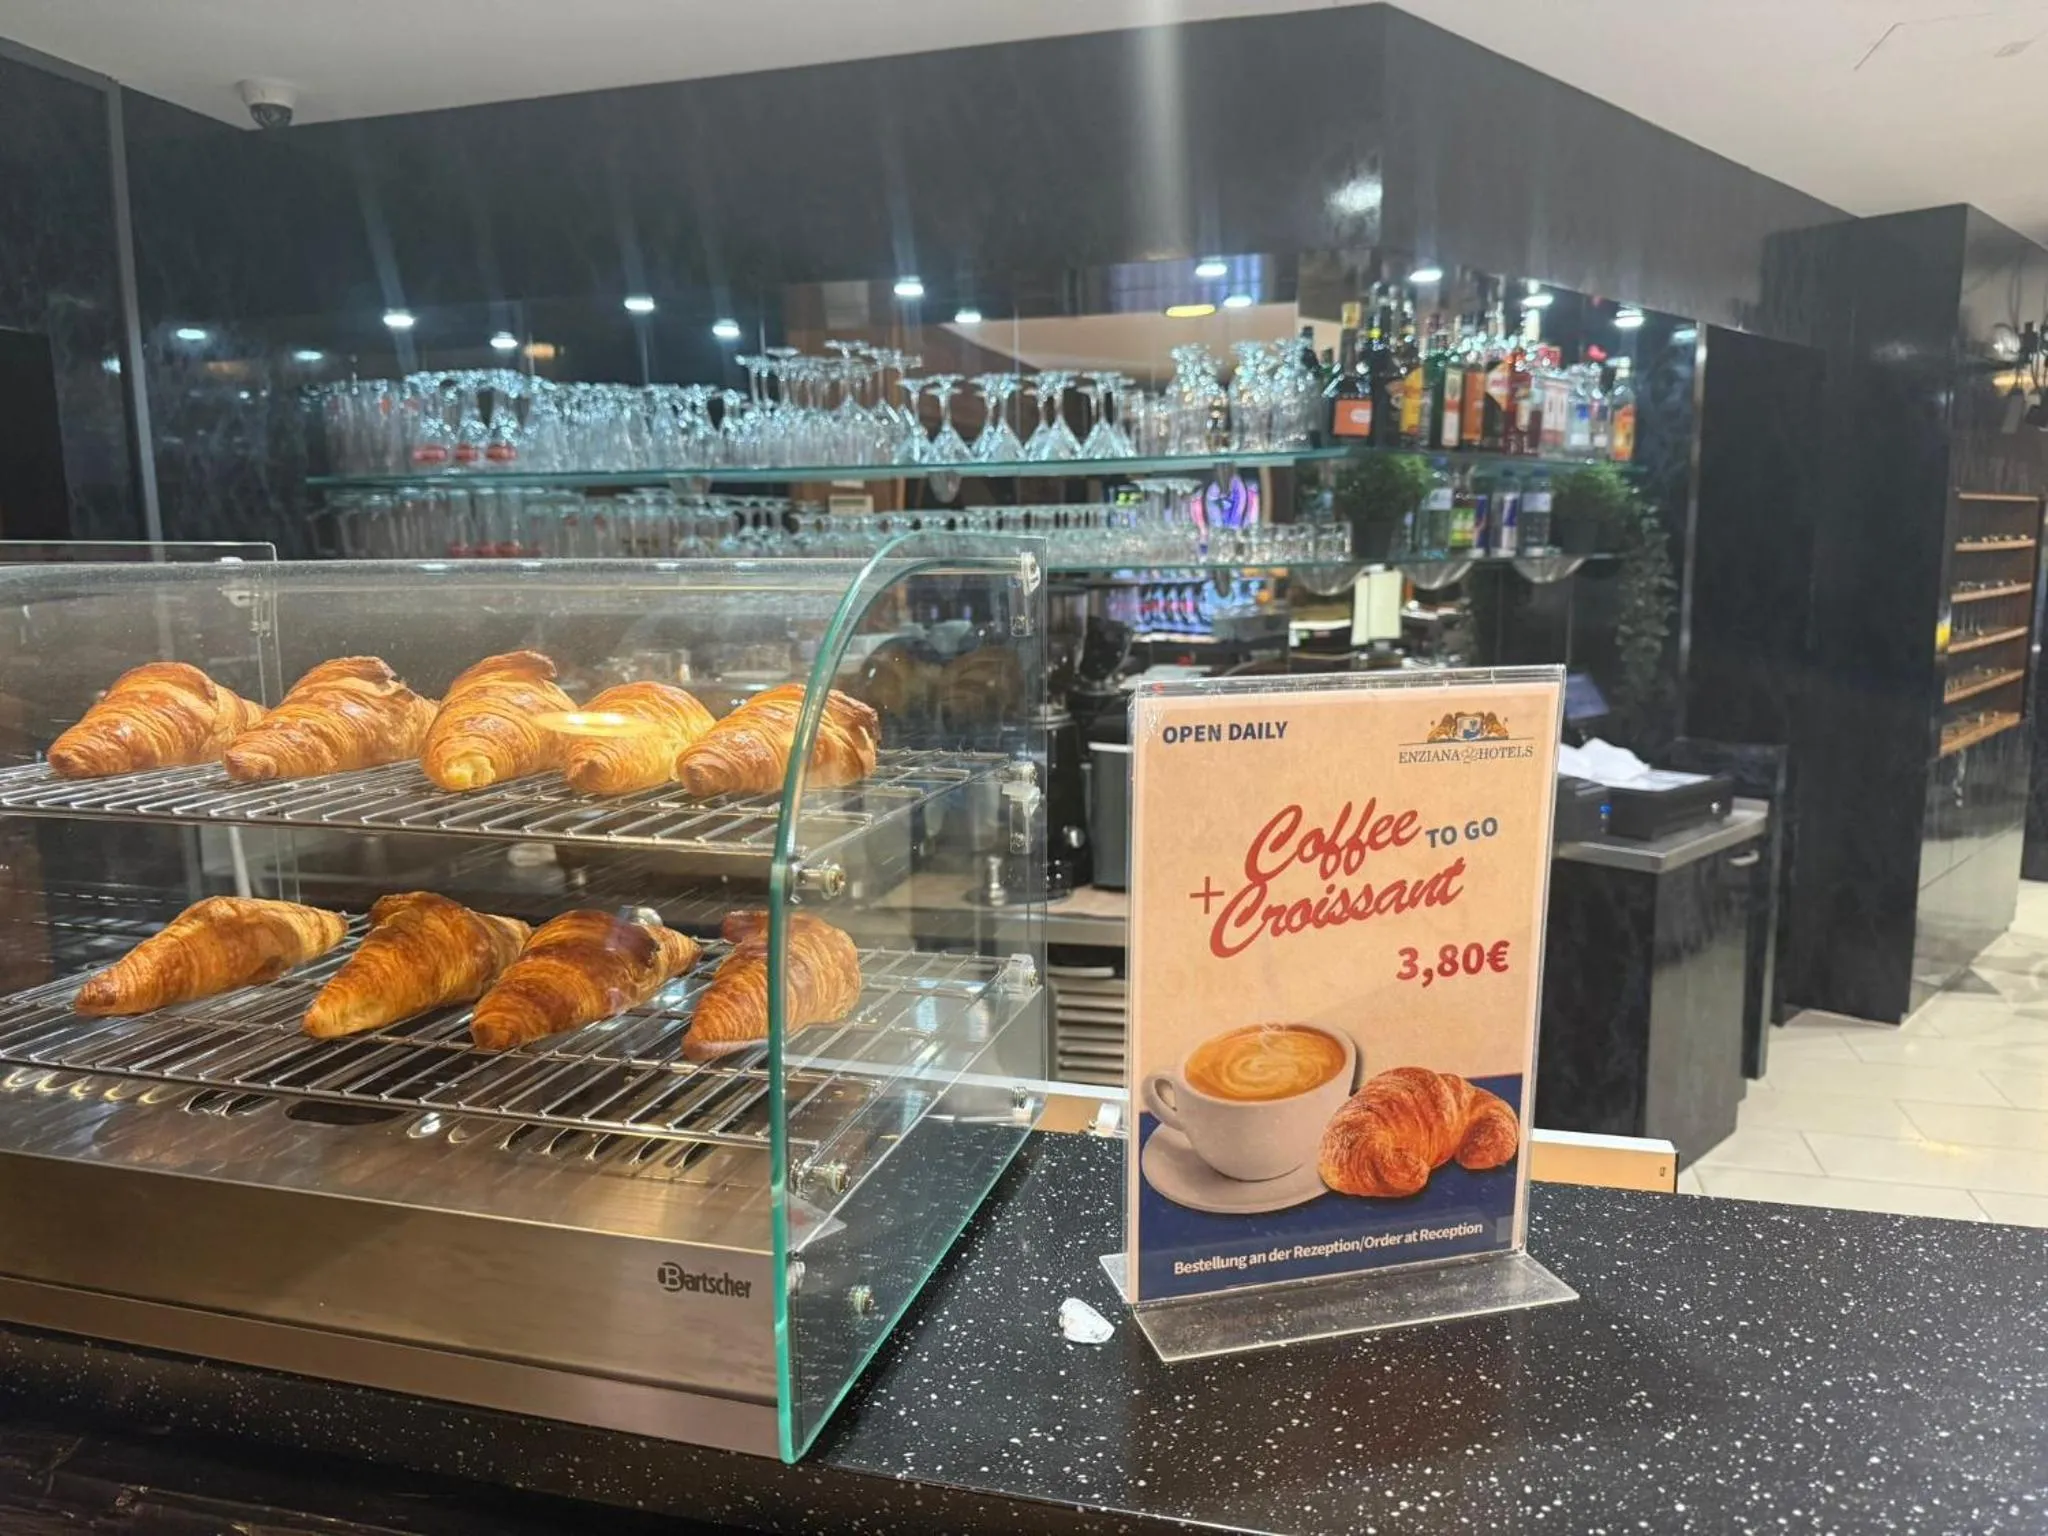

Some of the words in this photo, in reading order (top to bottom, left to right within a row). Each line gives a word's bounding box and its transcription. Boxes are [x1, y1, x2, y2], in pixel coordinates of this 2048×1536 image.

[1162, 724, 1222, 744] OPEN
[1228, 721, 1288, 741] DAILY
[1398, 749, 1460, 764] ENZIANA
[1477, 746, 1534, 761] HOTELS
[1244, 797, 1423, 884] Coffee
[1425, 825, 1458, 849] TO
[1464, 816, 1499, 841] GO
[1209, 857, 1466, 959] Croissant
[1396, 940, 1511, 988] 3,80€
[1174, 1255, 1248, 1275] Bestellung
[1249, 1252, 1266, 1265] an
[1268, 1247, 1292, 1262] der
[1293, 1232, 1402, 1257] Rezeption/Order
[1404, 1230, 1418, 1244] at
[1419, 1221, 1483, 1241] Reception
[657, 1261, 752, 1299] Bartscher
